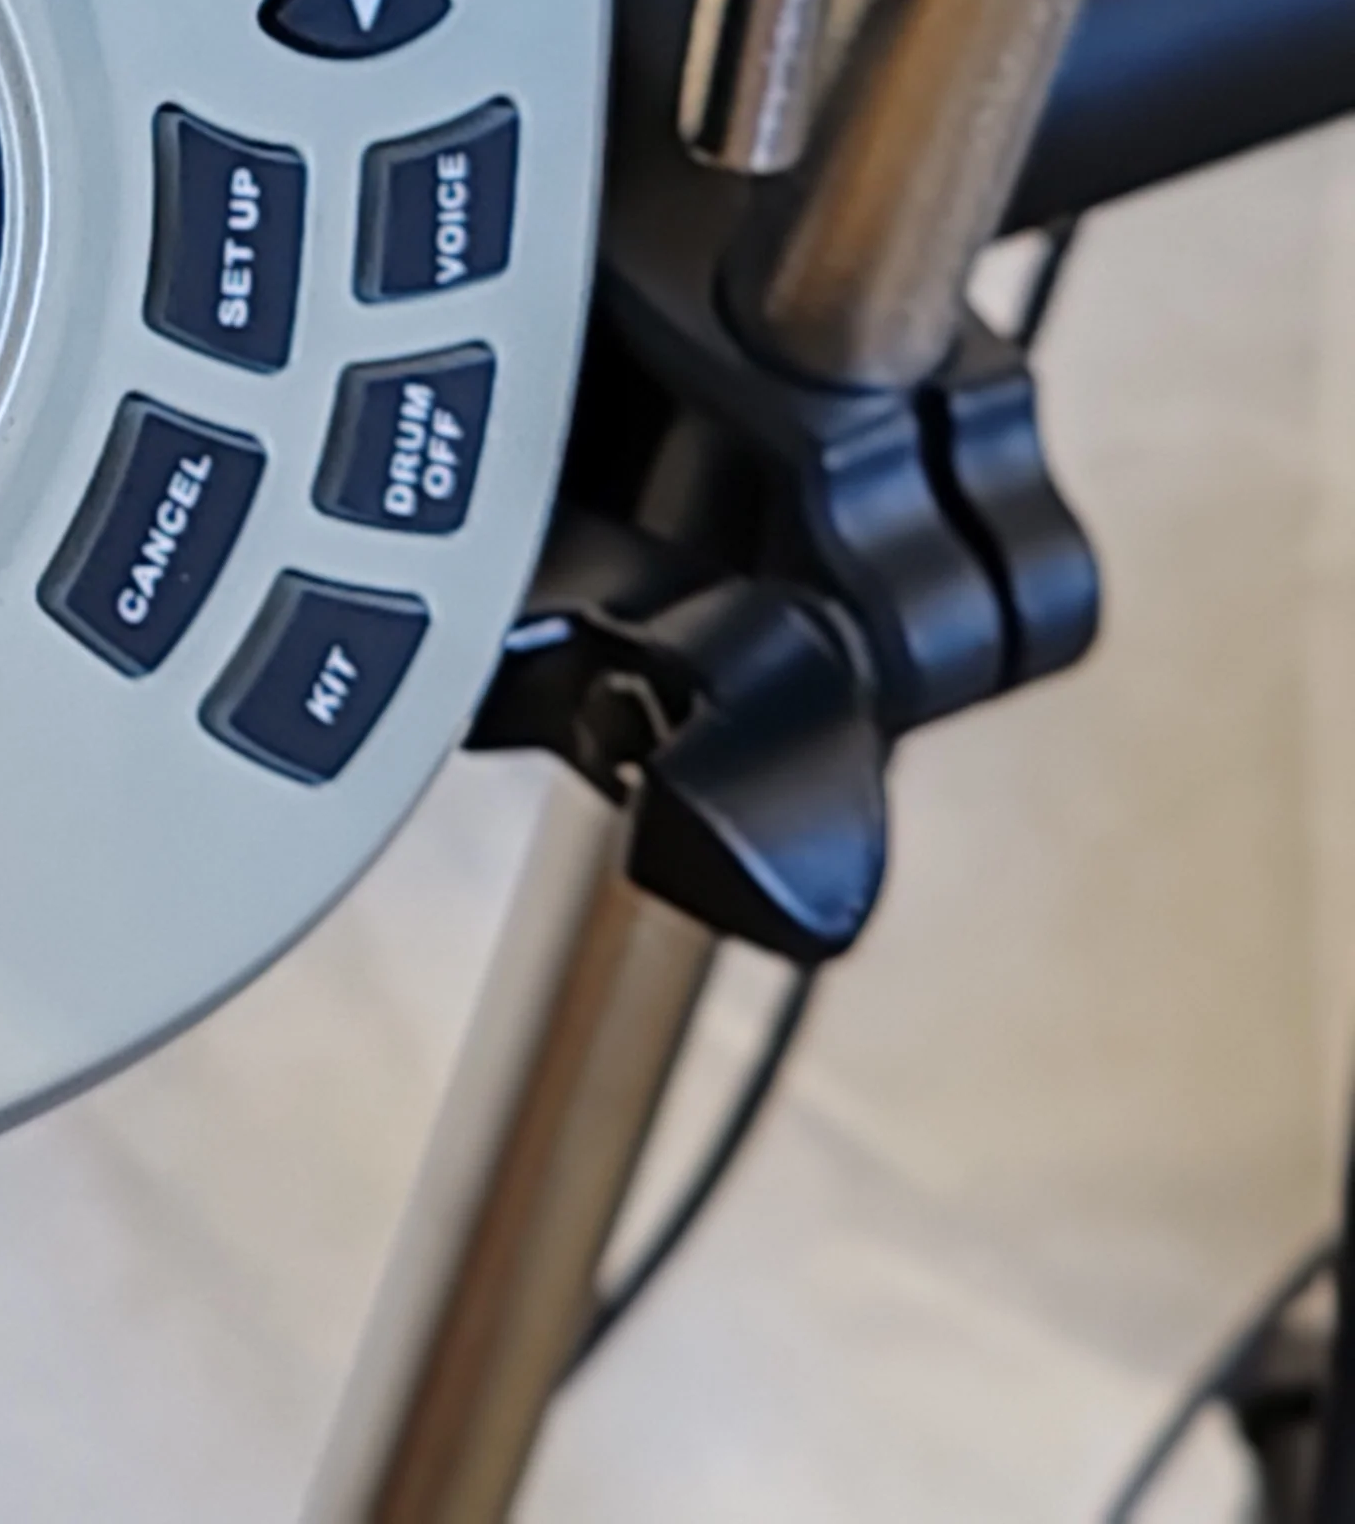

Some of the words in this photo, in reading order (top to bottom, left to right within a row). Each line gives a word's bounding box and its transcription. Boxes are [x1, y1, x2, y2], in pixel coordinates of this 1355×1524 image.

[226, 166, 262, 231] UP
[435, 152, 469, 285] VOICE
[217, 240, 256, 329] SET
[384, 382, 436, 517] DRUM
[421, 409, 467, 500] OFF
[116, 453, 214, 625] CANCEL
[305, 645, 360, 725] KIT
